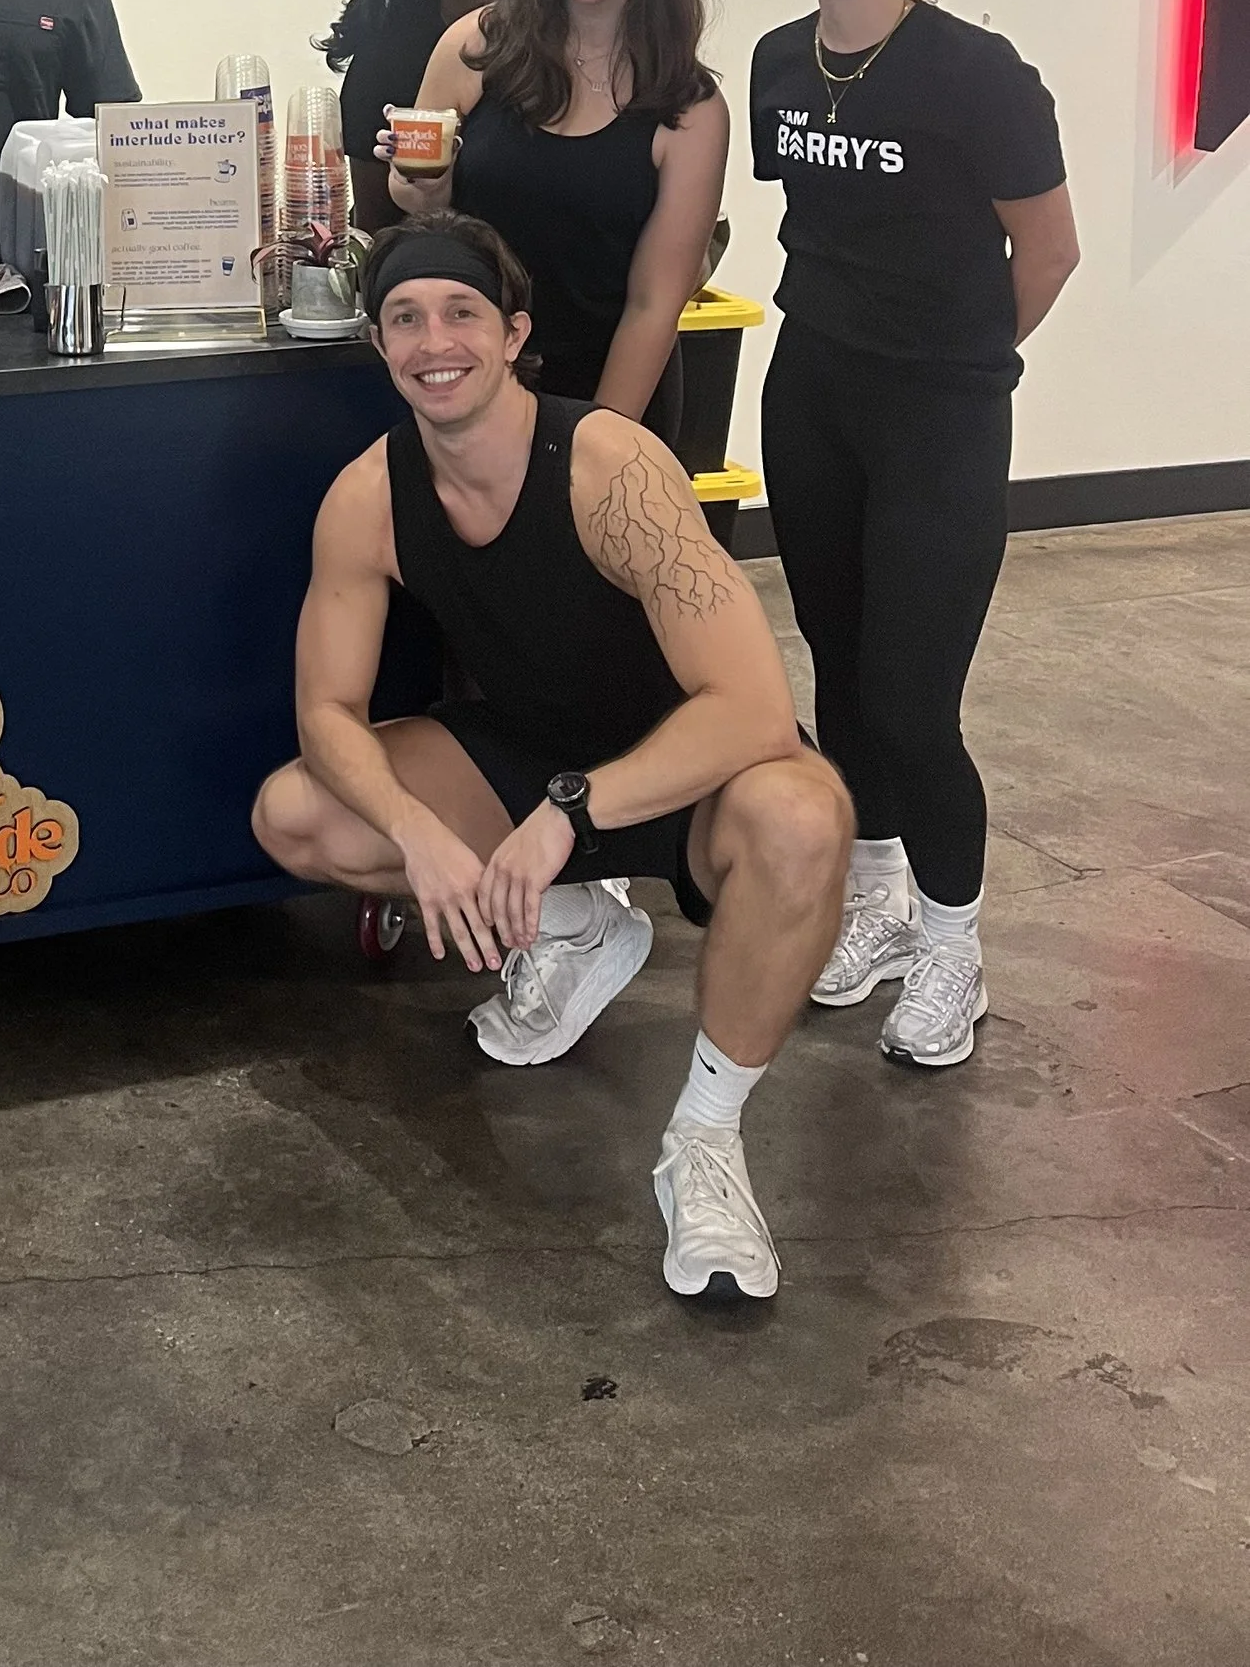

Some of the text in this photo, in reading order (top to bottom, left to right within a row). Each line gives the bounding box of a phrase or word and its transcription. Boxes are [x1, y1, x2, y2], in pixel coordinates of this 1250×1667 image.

[130, 116, 226, 130] what makes
[110, 130, 246, 147] interlude better?
